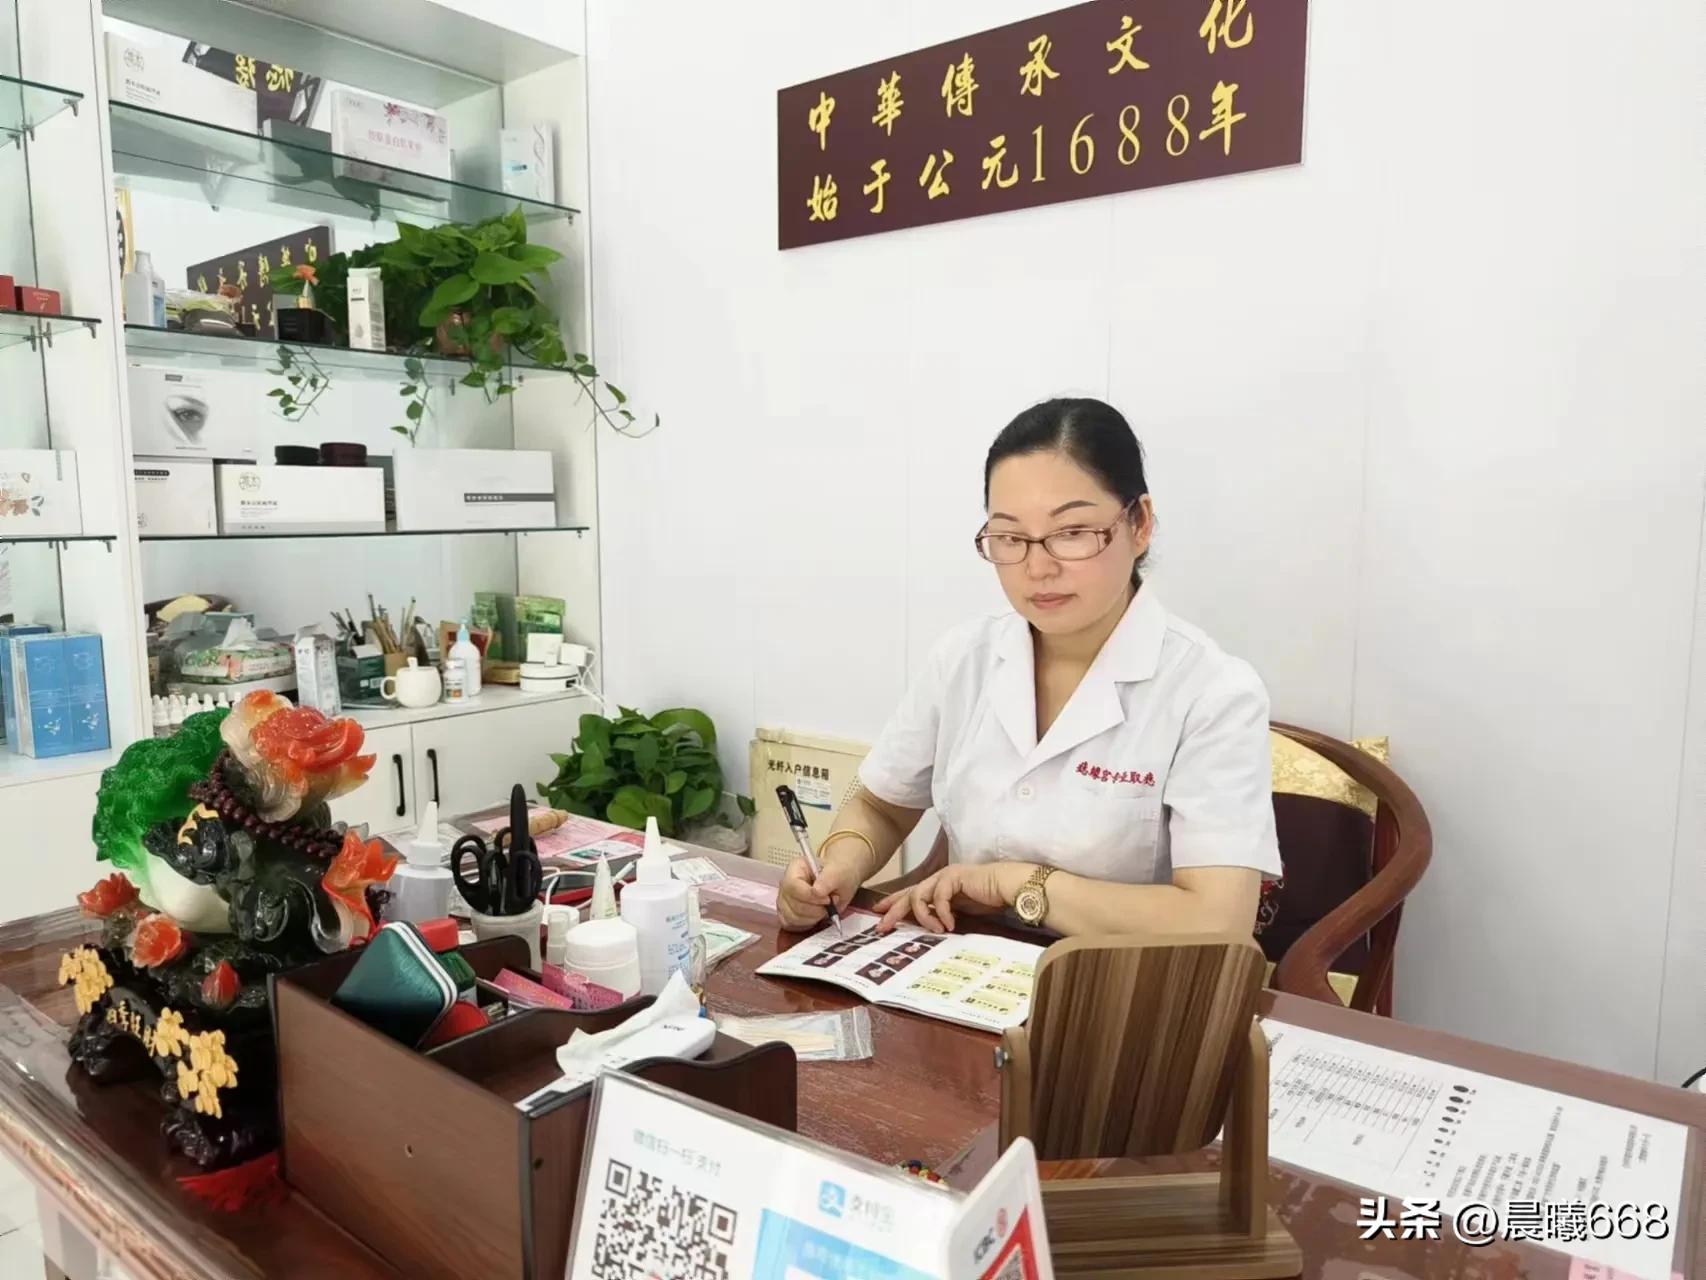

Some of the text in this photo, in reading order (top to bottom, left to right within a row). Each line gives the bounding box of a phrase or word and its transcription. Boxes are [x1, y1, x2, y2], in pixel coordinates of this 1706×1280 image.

[806, 80, 1247, 224] 始于公元1688年
[767, 759, 830, 781] 光纤入户信息箱
